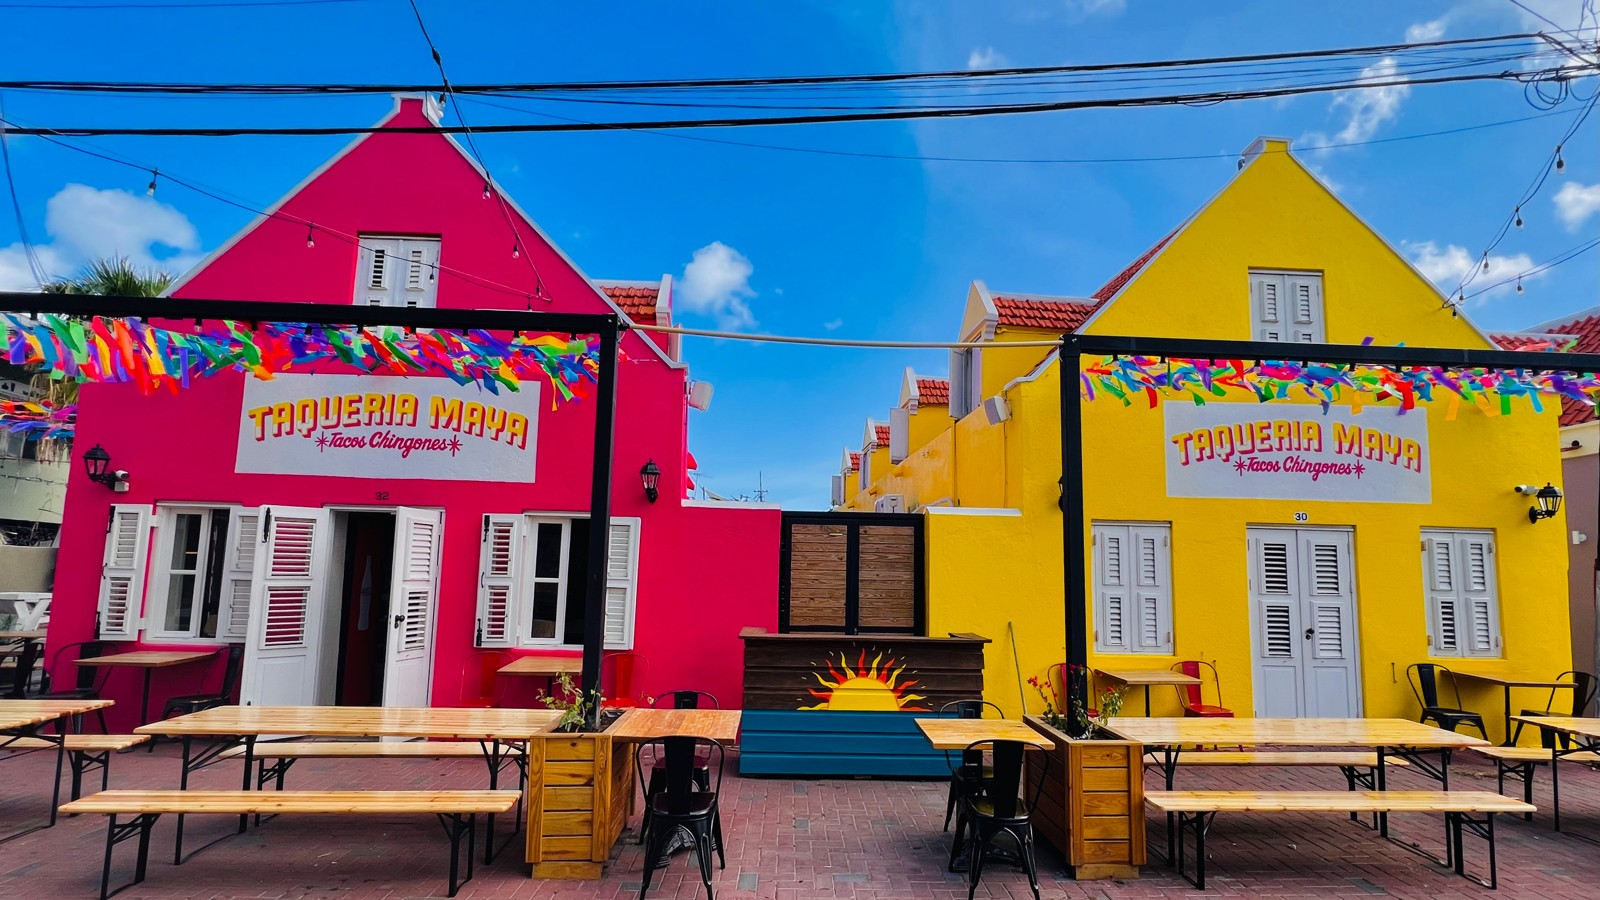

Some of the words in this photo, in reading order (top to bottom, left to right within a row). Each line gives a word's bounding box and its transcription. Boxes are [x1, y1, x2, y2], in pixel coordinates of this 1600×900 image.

[248, 393, 419, 442] TAQUERIA
[430, 395, 529, 450] MAYA
[328, 432, 367, 449] Tacos
[369, 430, 447, 458] Chingones
[1171, 420, 1322, 466] TAQUERIA
[1332, 422, 1421, 473] MAYA
[1247, 456, 1281, 472] Tacos
[1283, 455, 1353, 481] Chingones
[375, 491, 389, 501] 32
[1294, 512, 1308, 521] 30
